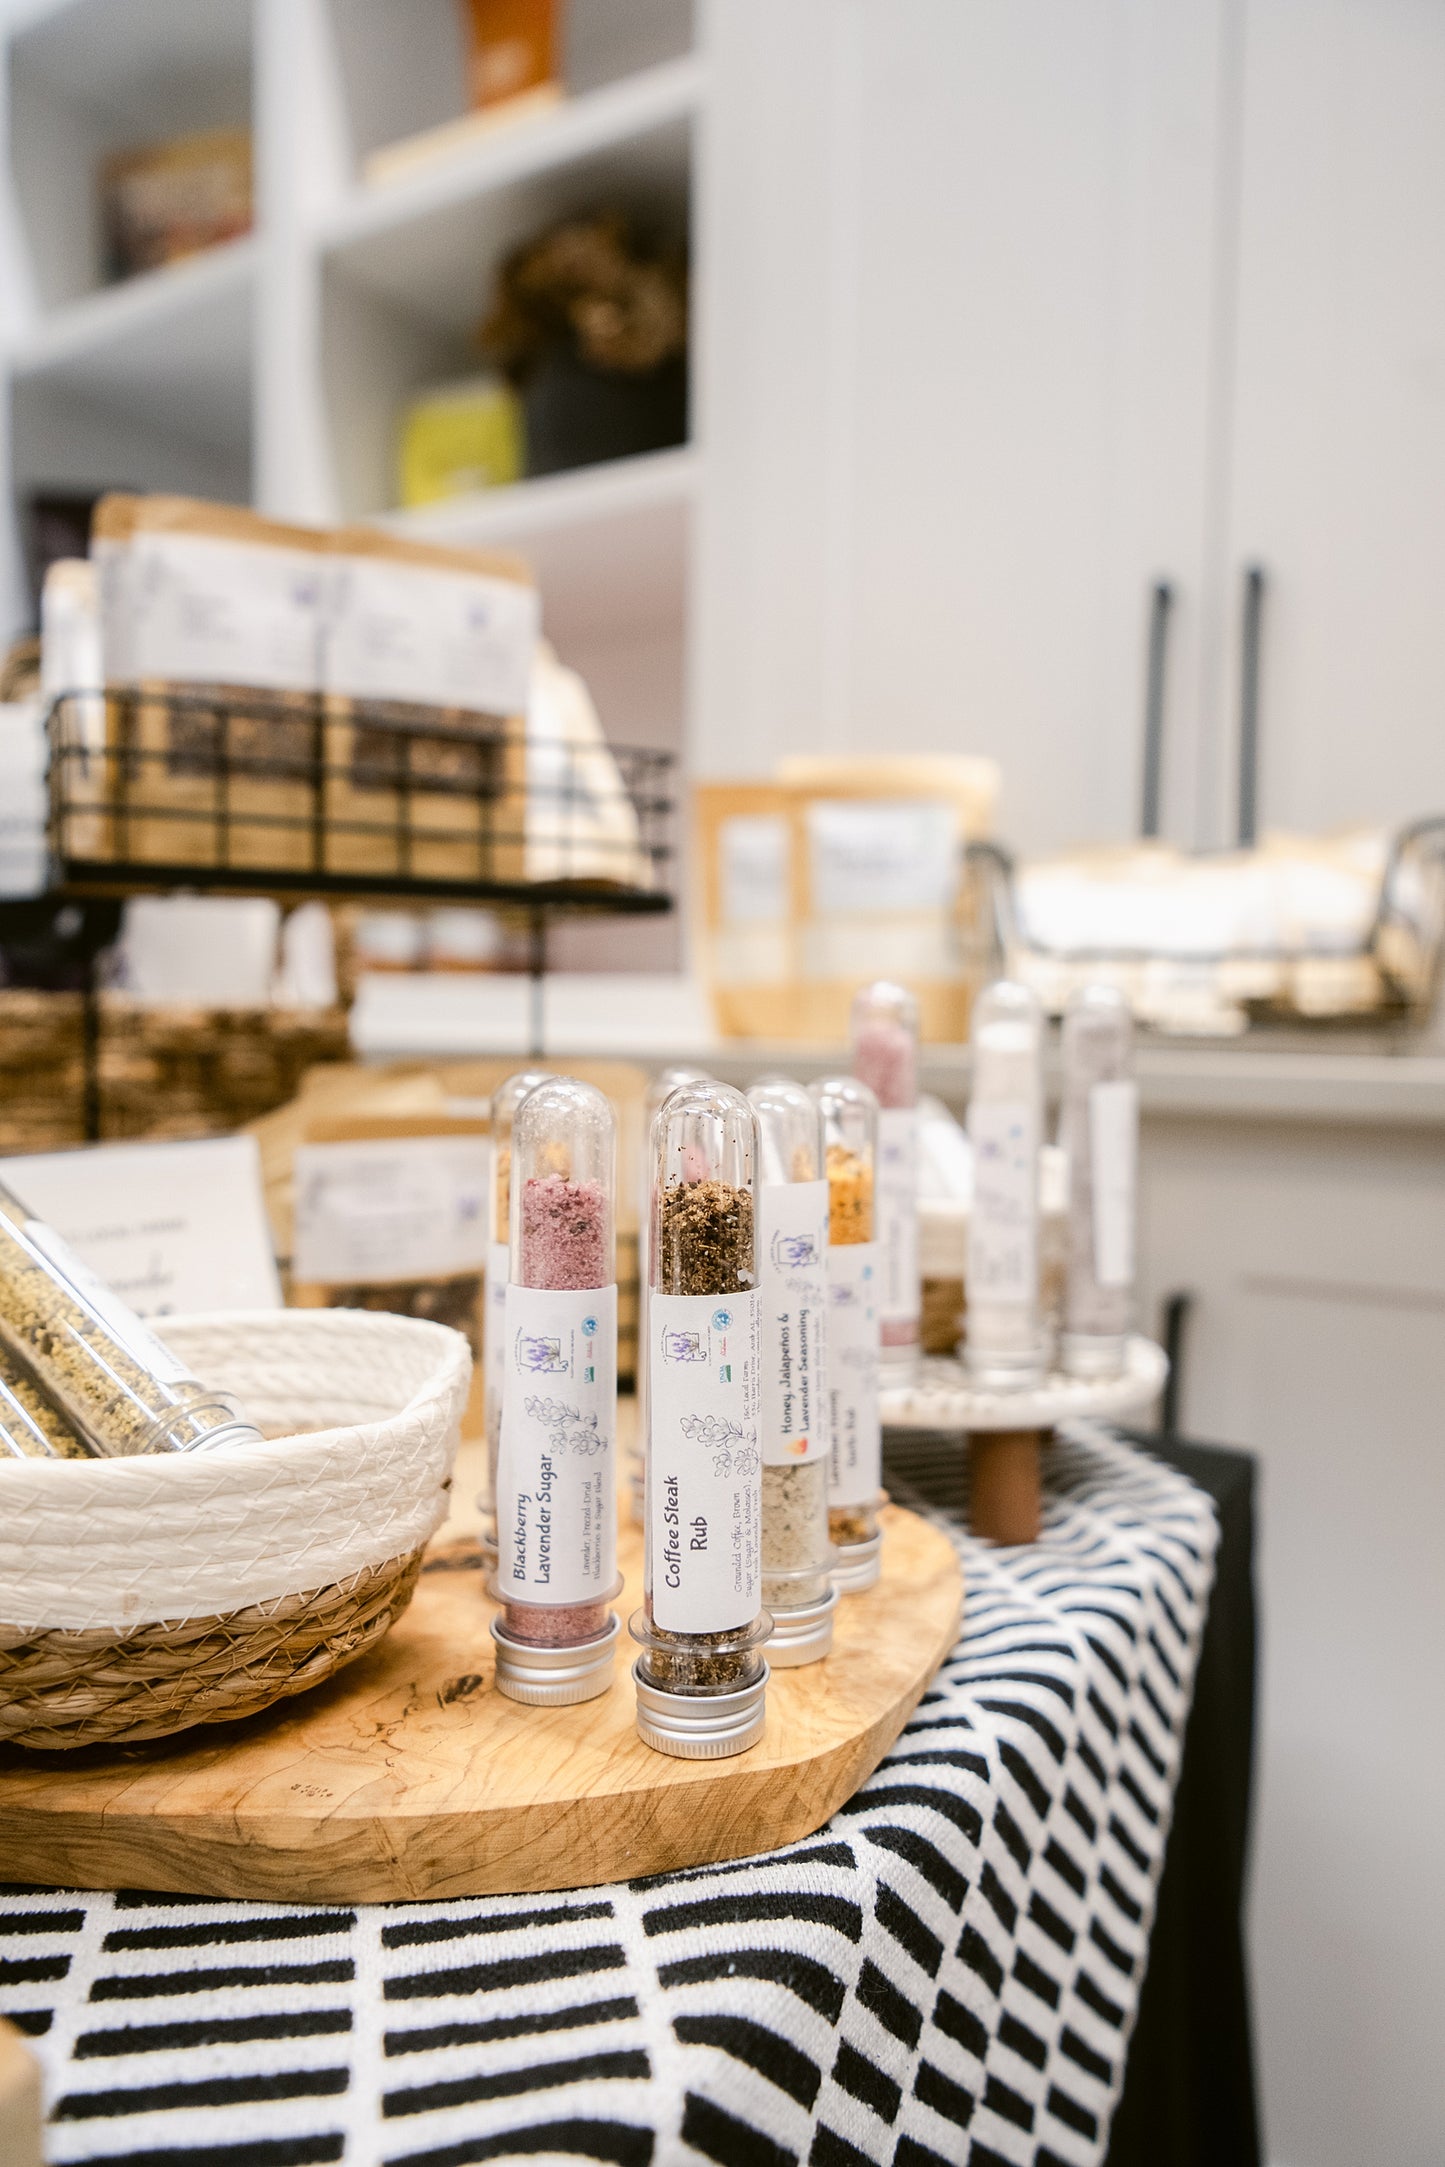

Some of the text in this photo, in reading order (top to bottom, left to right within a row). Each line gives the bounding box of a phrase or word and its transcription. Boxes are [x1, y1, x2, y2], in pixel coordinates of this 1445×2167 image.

[778, 1313, 795, 1434] Honey, Jalapeños &
[797, 1309, 810, 1432] Lavender Seasoning
[513, 1493, 532, 1581] Blackberry
[535, 1453, 558, 1584] Lavender Sugar
[594, 1496, 604, 1520] Sugar
[664, 1475, 681, 1589] Coffee Steak
[690, 1516, 708, 1551] Rub
[731, 1492, 745, 1593] Grounded Coffee, Brown
[745, 1528, 752, 1537] &
[745, 1540, 754, 1568] (Sugar
[746, 1572, 754, 1598] Sugar
